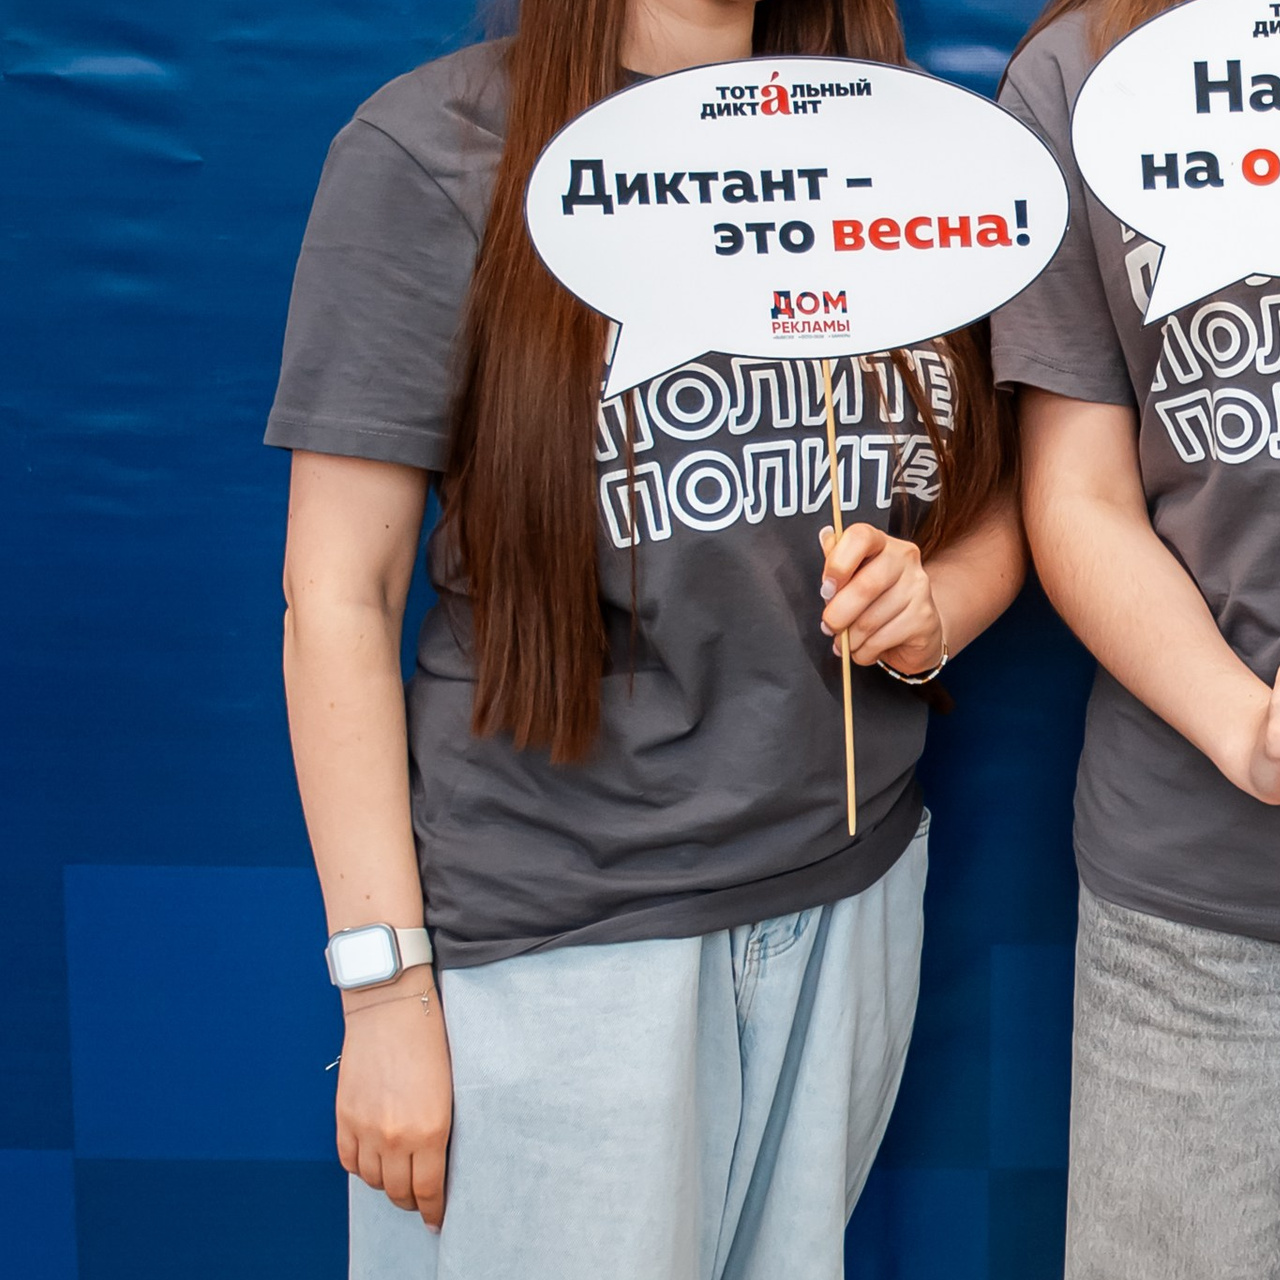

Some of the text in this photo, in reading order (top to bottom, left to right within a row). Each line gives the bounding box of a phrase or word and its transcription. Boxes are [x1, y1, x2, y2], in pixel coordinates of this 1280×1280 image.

[562, 159, 828, 215] Диктант
[1141, 151, 1224, 190] на
[714, 200, 1031, 255] это весна!
[770, 290, 848, 320] ДОМ
[771, 319, 850, 334] РЕКЛАМЫ
